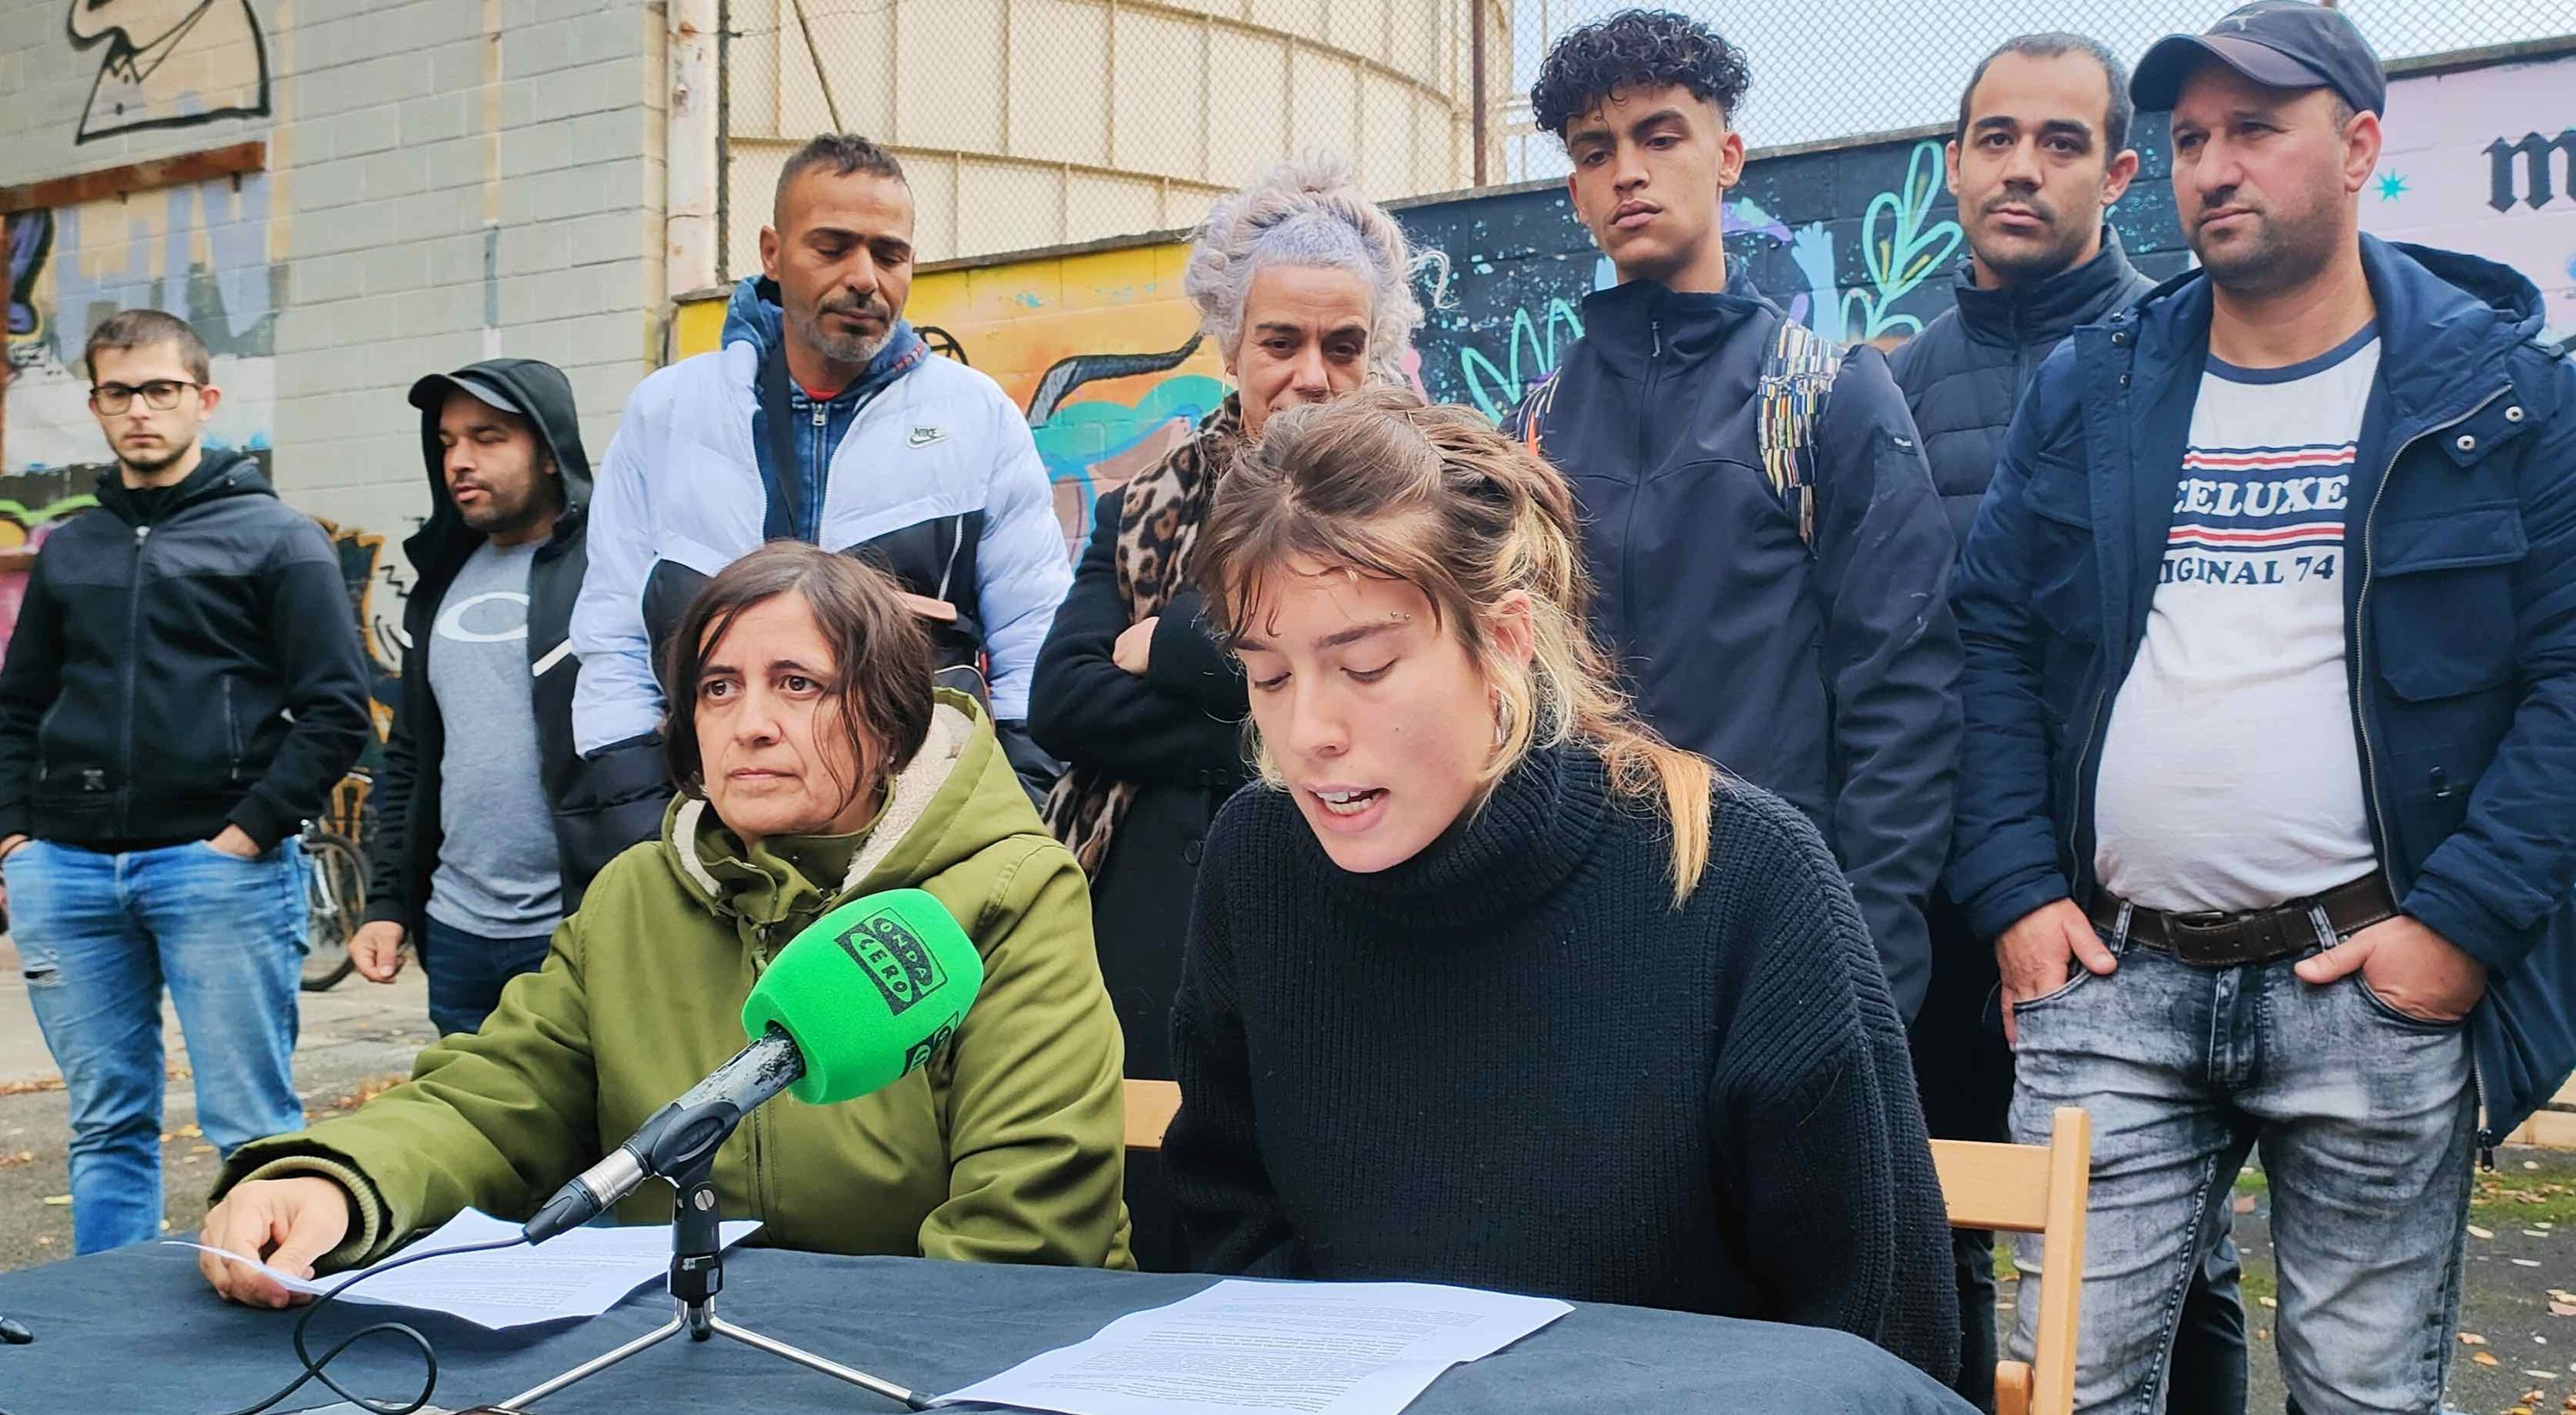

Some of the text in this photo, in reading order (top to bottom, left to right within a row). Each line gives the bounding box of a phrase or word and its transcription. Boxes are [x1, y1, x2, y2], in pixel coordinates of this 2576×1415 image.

[2158, 555, 2335, 585] IGINAL 74
[859, 938, 908, 993] CERO
[878, 920, 928, 980] ONDA
